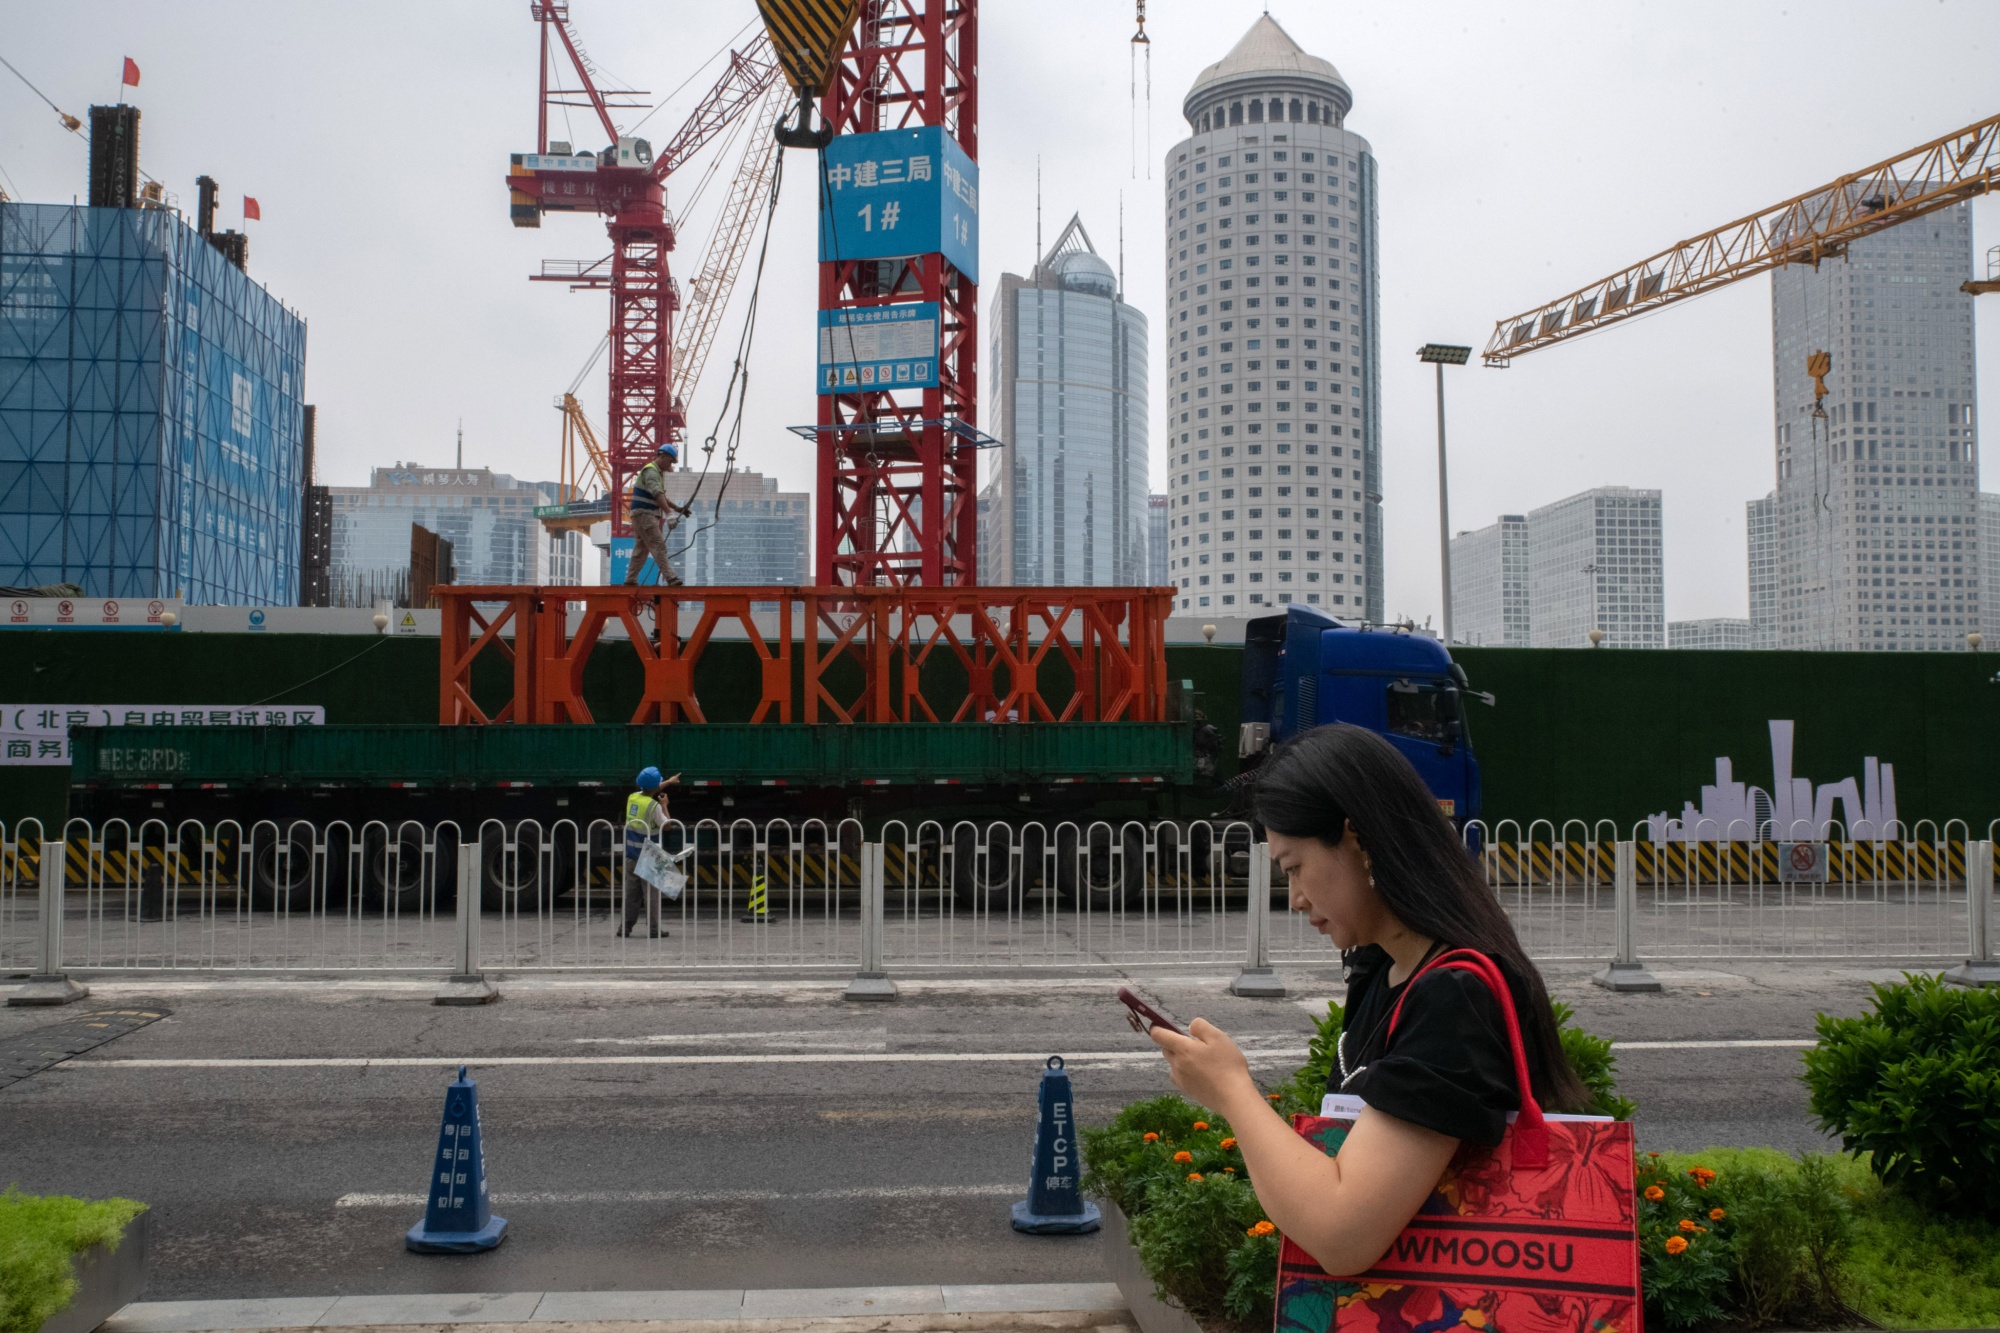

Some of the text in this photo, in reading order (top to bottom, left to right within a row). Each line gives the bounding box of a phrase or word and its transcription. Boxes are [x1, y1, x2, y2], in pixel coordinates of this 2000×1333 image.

[828, 155, 932, 191] 中建三局
[944, 160, 977, 214] 中建三局
[857, 201, 900, 232] 1#
[953, 213, 968, 247] 1#
[423, 473, 479, 486] 横琴人寿
[0, 709, 316, 730] （北京）自由贸易试验区
[0, 740, 72, 758] 商务
[1053, 1103, 1068, 1173] ETCP
[1379, 1236, 1574, 1272] WMOOSU
